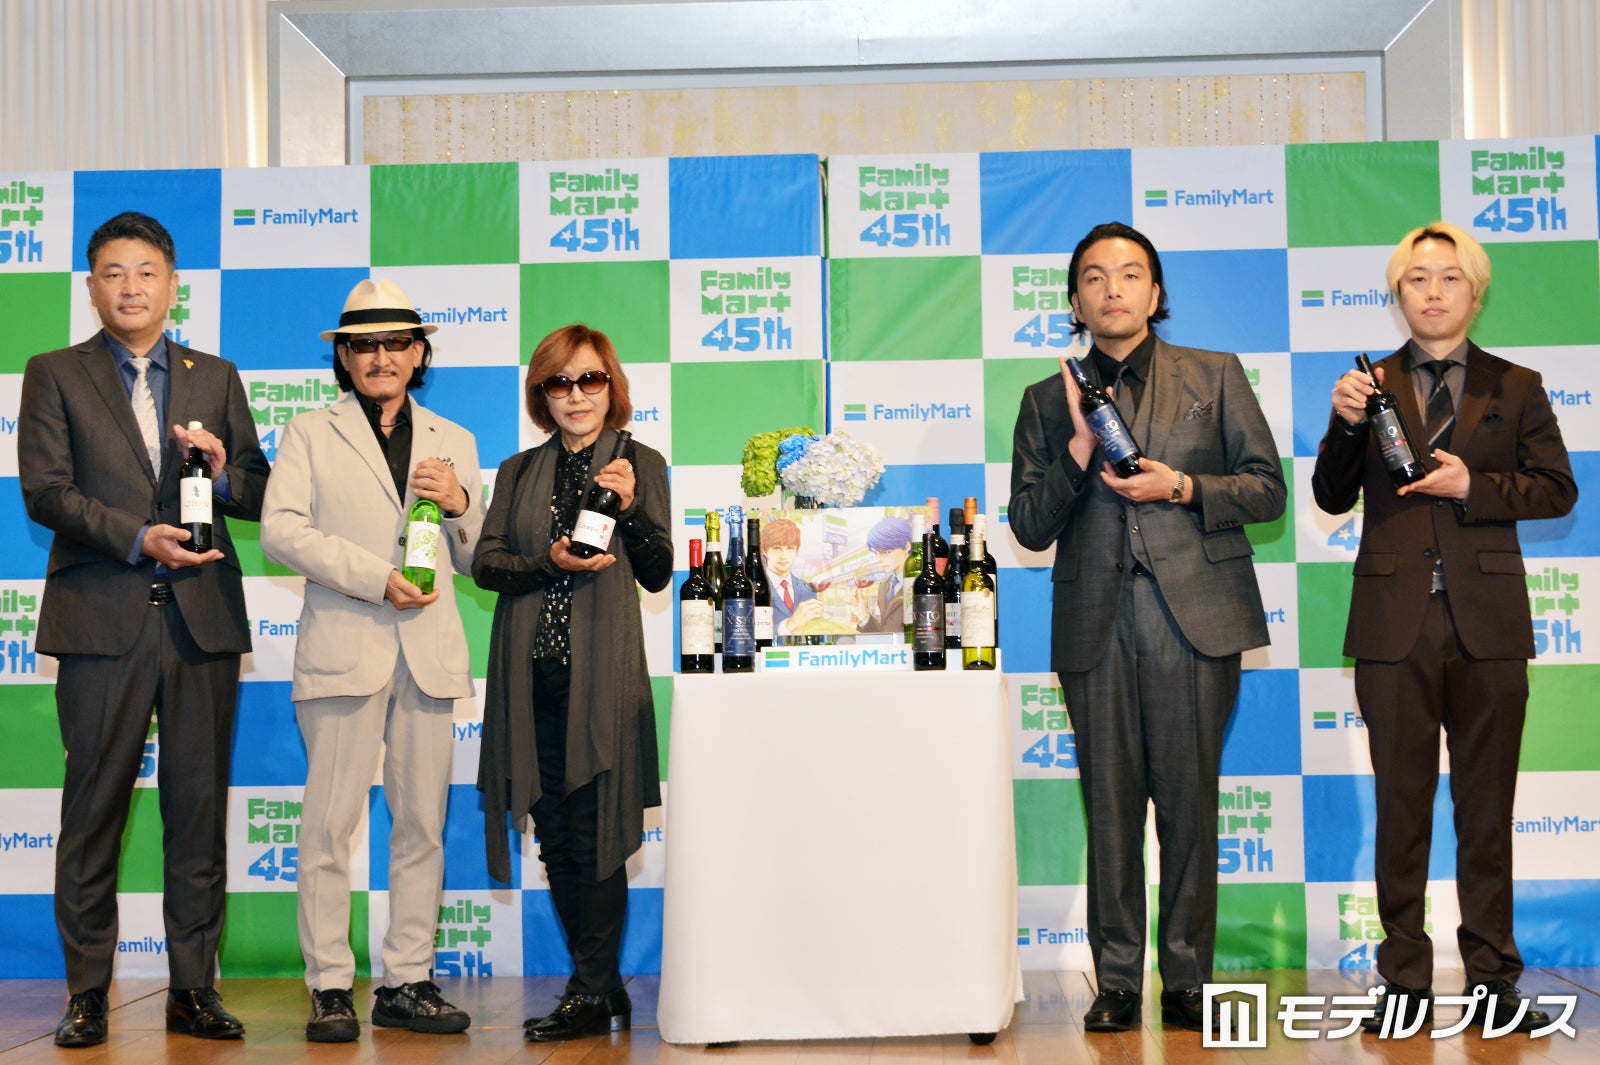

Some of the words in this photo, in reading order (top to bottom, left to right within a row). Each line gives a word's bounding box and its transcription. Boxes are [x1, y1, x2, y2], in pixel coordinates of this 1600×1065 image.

[1472, 147, 1564, 172] Family
[550, 169, 639, 192] Family
[859, 164, 949, 187] Family
[1473, 172, 1565, 195] Mart
[550, 194, 639, 216] Mart
[860, 188, 949, 211] Mart
[1175, 188, 1273, 207] FamilyMart
[0, 206, 43, 227] rt
[262, 208, 358, 226] FamilyMart
[1473, 197, 1567, 232] 45th
[550, 218, 640, 252] 45th
[860, 213, 950, 247] 45th
[701, 267, 791, 291] Family
[1013, 266, 1068, 287] Fam
[701, 292, 791, 315] Mart
[1332, 290, 1392, 307] Family
[702, 317, 792, 352] 45th
[874, 404, 970, 420] FamilyMart
[1526, 568, 1578, 591] mily
[0, 616, 36, 637] rt
[799, 650, 906, 667] FamilyMart
[1022, 711, 1067, 730] Ma
[1022, 734, 1078, 769] 45
[248, 798, 302, 819] Fam
[1218, 786, 1271, 809] mily
[1516, 816, 1600, 833] amilyMar
[0, 832, 53, 851] lyMart
[248, 847, 298, 882] 45
[1217, 837, 1273, 874] 5th
[438, 901, 490, 923] mily
[435, 926, 490, 947] art
[430, 951, 493, 977] 5th
